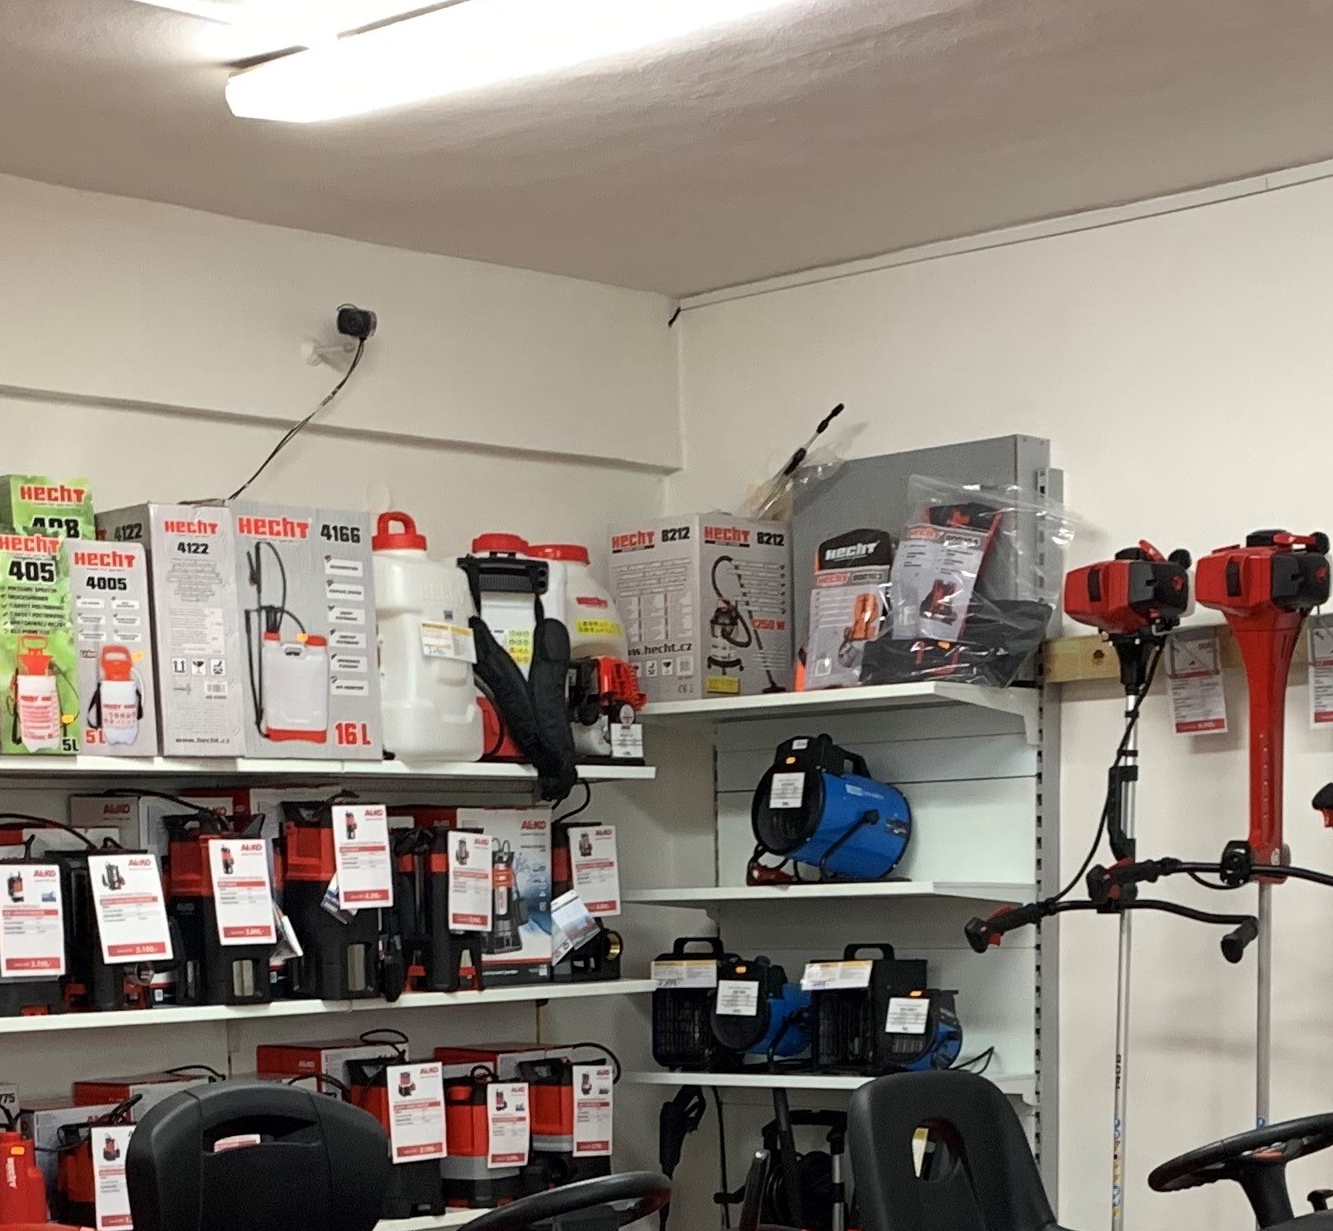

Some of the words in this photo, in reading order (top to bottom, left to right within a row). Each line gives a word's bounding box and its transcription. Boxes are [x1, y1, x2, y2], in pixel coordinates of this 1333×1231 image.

[320, 523, 362, 545] 4166
[661, 526, 691, 543] 8212
[756, 531, 785, 547] 8212
[177, 541, 210, 555] 4122
[8, 560, 56, 583] 405
[86, 576, 128, 591] 4005
